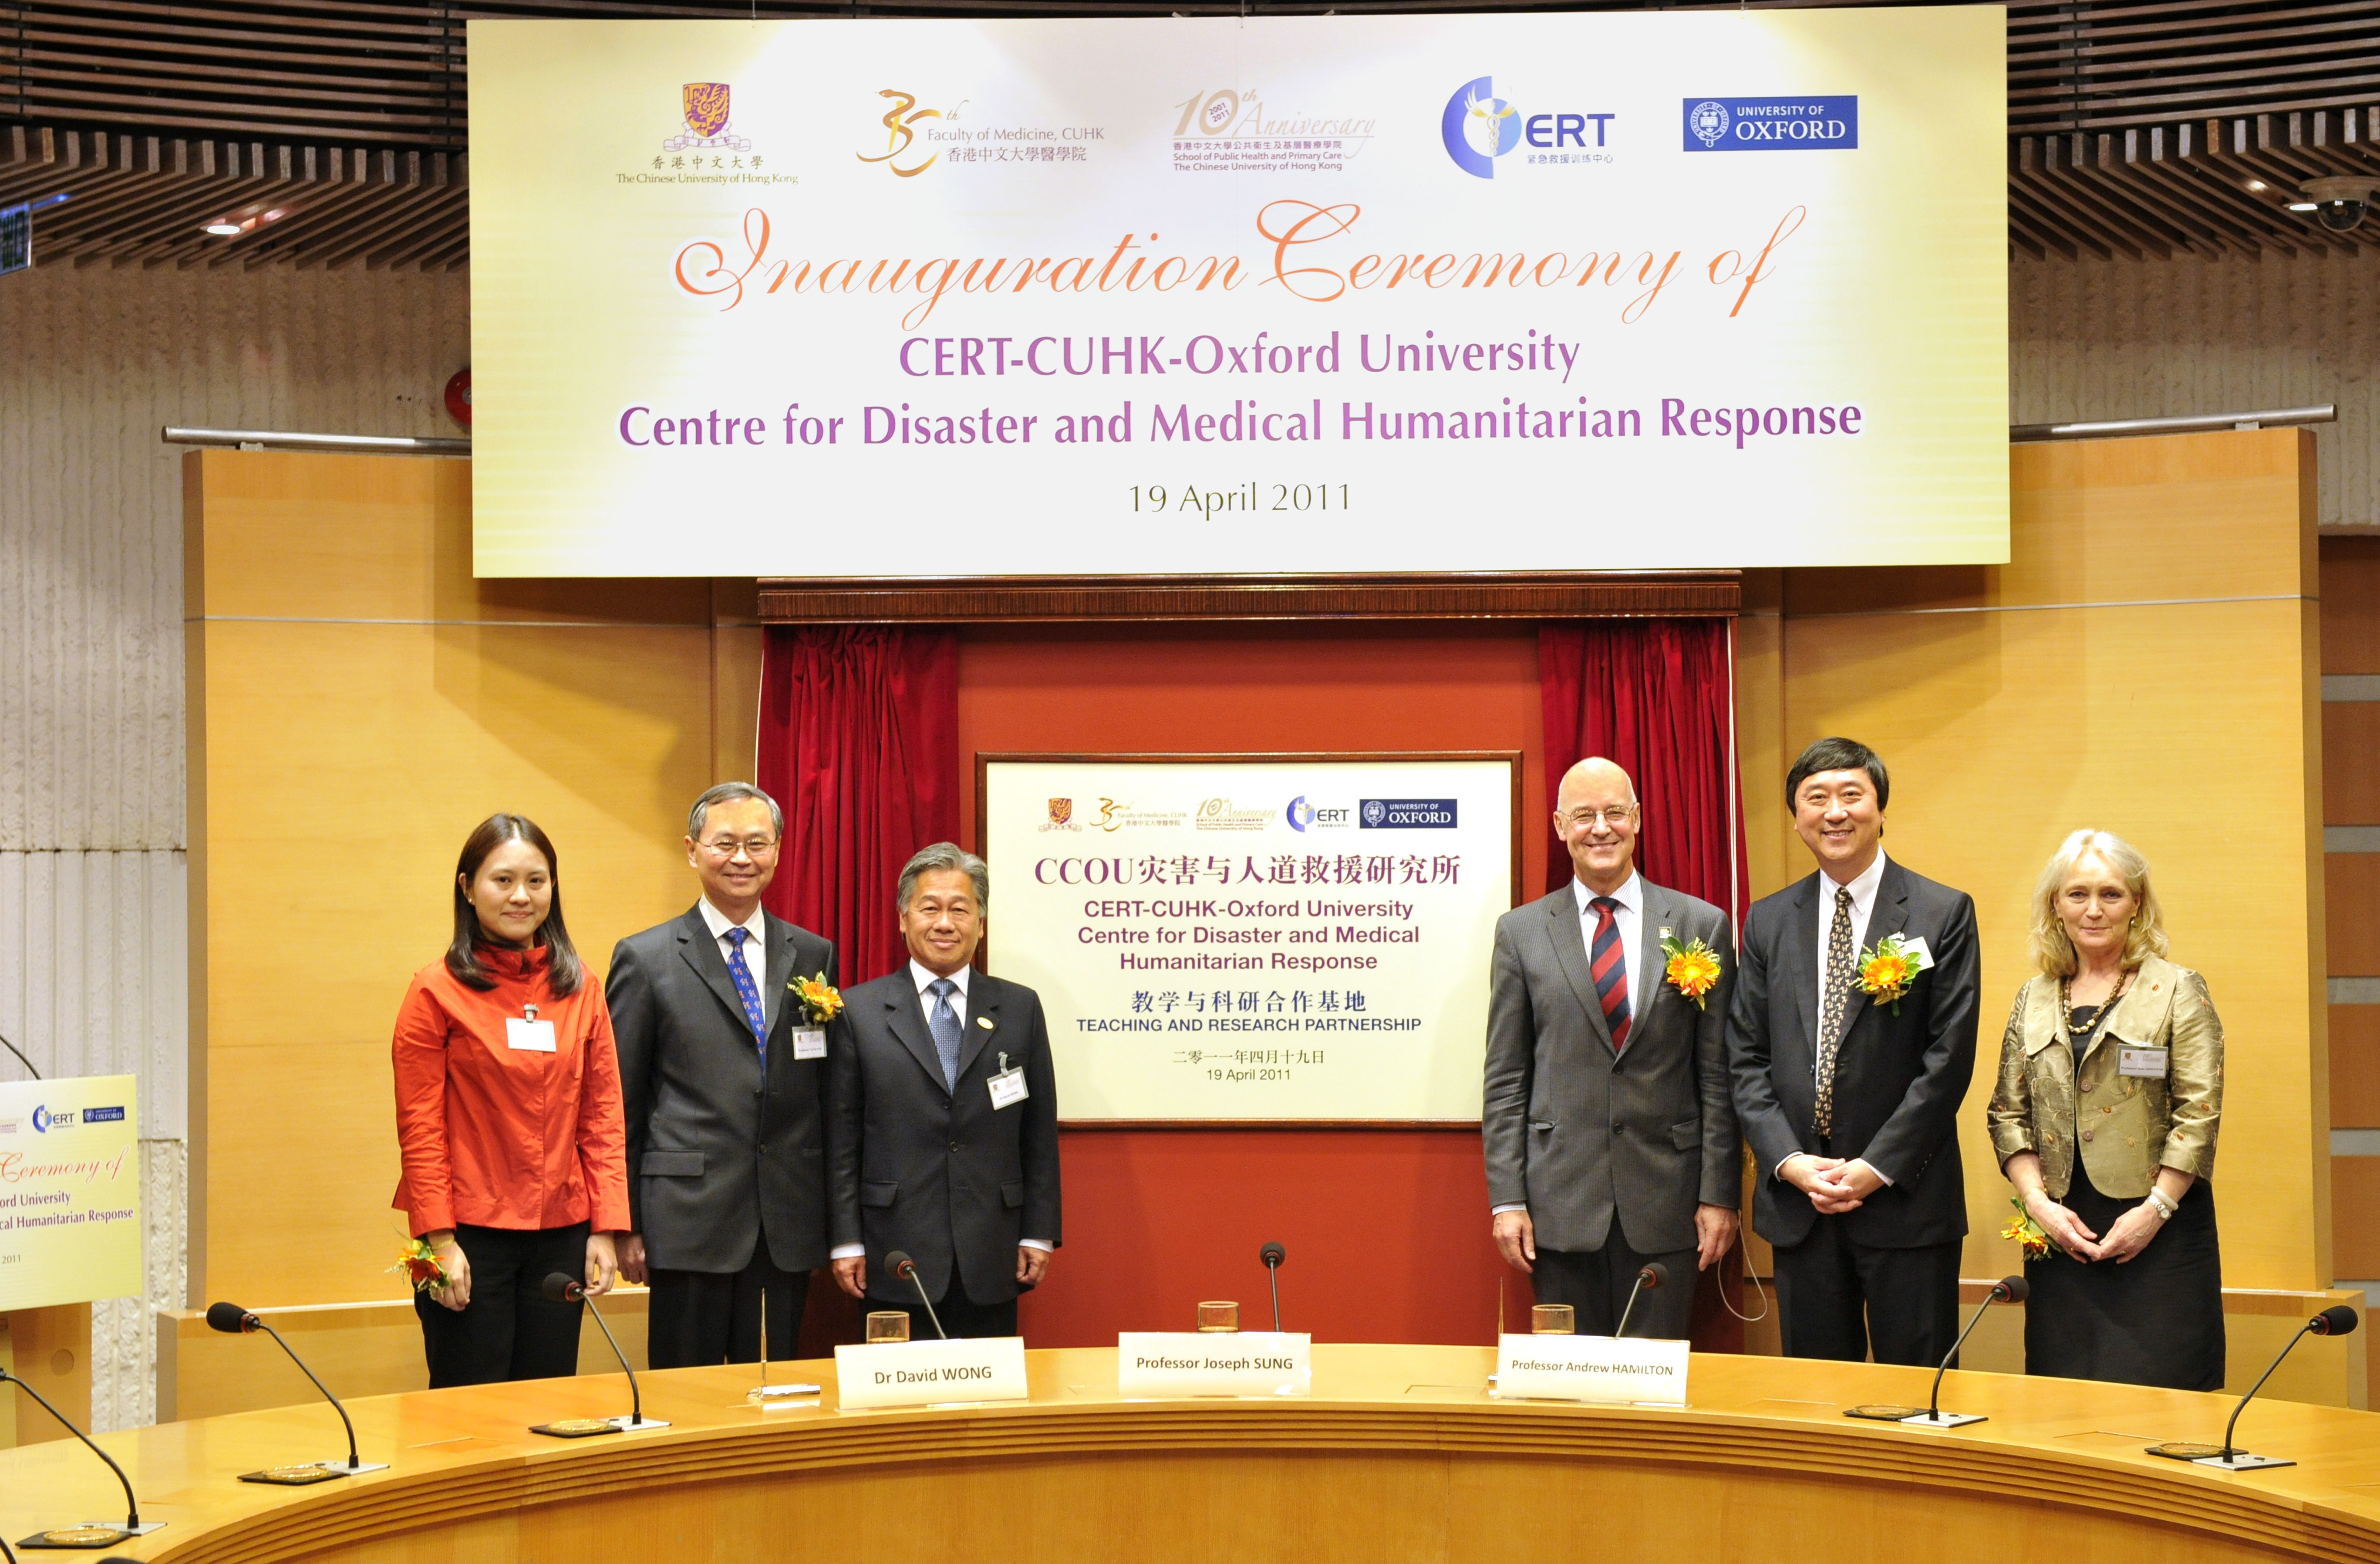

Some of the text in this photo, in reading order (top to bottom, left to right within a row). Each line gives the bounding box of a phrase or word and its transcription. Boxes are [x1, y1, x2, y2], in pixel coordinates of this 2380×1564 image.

[1208, 102, 1227, 116] 2001
[1212, 109, 1231, 123] 2011
[1737, 105, 1825, 117] UNIVERSITY OF
[928, 127, 1104, 143] Faculty of Medicine, CUHK
[1231, 101, 1376, 159] Anniversary
[1735, 120, 1846, 140] OXFORD
[947, 146, 1087, 163] 香港中文大學醫學院
[1174, 151, 1342, 162] School of Public Health and Primary Care
[651, 155, 764, 171] 香港中文大學
[1174, 163, 1191, 171] The
[1232, 163, 1277, 172] University
[1279, 162, 1289, 170] of
[1291, 162, 1316, 172] Hong
[1319, 162, 1343, 171] Kong
[616, 173, 799, 186] The Chinese University of Hong Kong
[675, 200, 1806, 332] Inauguration Ceremony of
[899, 329, 1580, 384] CERT-CUHK-Oxford University
[619, 396, 1863, 450] Centre for Disaster and Medical Humanitarian Response
[1128, 481, 1351, 522] 19 April 2011
[1219, 803, 1277, 826] Anniversary
[1388, 811, 1451, 824] OXFORD
[1034, 854, 1461, 885] CCOU灾害与人道救援研究所
[1084, 899, 1414, 920] CERT-CUHK-Oxford University
[1078, 926, 1420, 945] Centre for Disaster and Medical
[1120, 953, 1378, 973] Humanitarian Response
[1131, 990, 1367, 1013] 教学与科研合作基地
[1077, 1018, 1422, 1033] TEACHING AND RESEARCH PARTNERSHIP
[1172, 1049, 1325, 1065] 二零一一年四月十九日
[1206, 1068, 1291, 1084] 19 April 2011
[95, 1112, 123, 1120] OXFORD
[0, 1146, 129, 1184] Ceremony of
[21, 1190, 70, 1206] University
[17, 1211, 85, 1228] Humanitarian
[89, 1208, 134, 1224] Response
[2, 1255, 21, 1264] 2011
[1137, 1357, 1293, 1371] Professor Joseph SUNG
[1512, 1360, 1673, 1376] Professor Andrew HAMILTON
[875, 1366, 992, 1384] Dr David WONG
